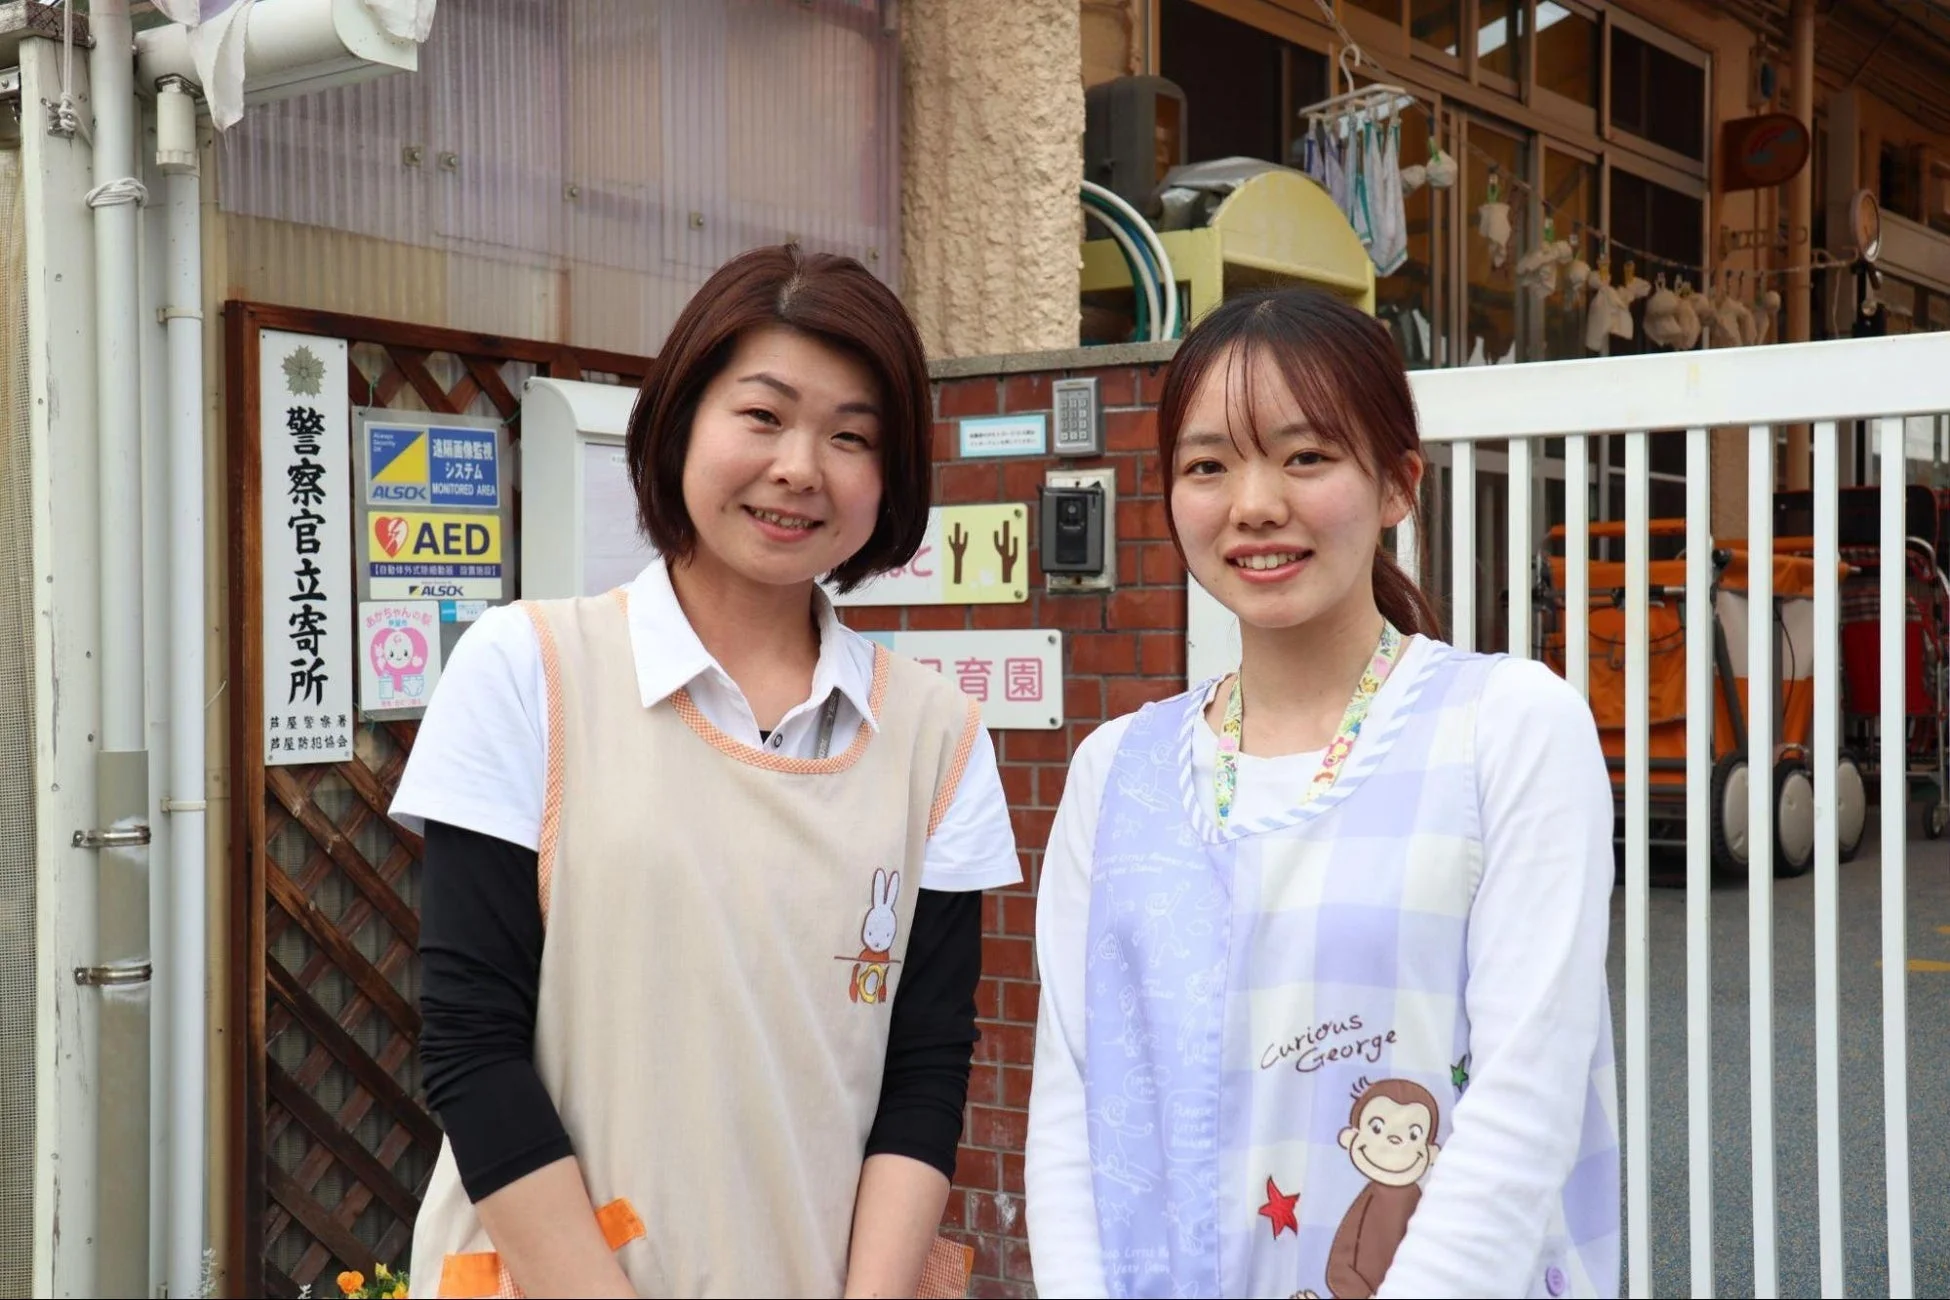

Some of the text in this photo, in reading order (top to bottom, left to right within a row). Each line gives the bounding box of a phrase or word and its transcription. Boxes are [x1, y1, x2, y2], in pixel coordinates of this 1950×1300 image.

[445, 462, 484, 480] システム
[372, 486, 427, 500] ALSOK
[432, 483, 497, 496] MONITORED AREA
[412, 522, 490, 555] AED
[286, 406, 328, 706] 警察官立寄所
[421, 586, 464, 597] ALSOK
[914, 657, 1043, 703] 育園
[1260, 1014, 1363, 1070] Curious
[1295, 1029, 1397, 1073] George
